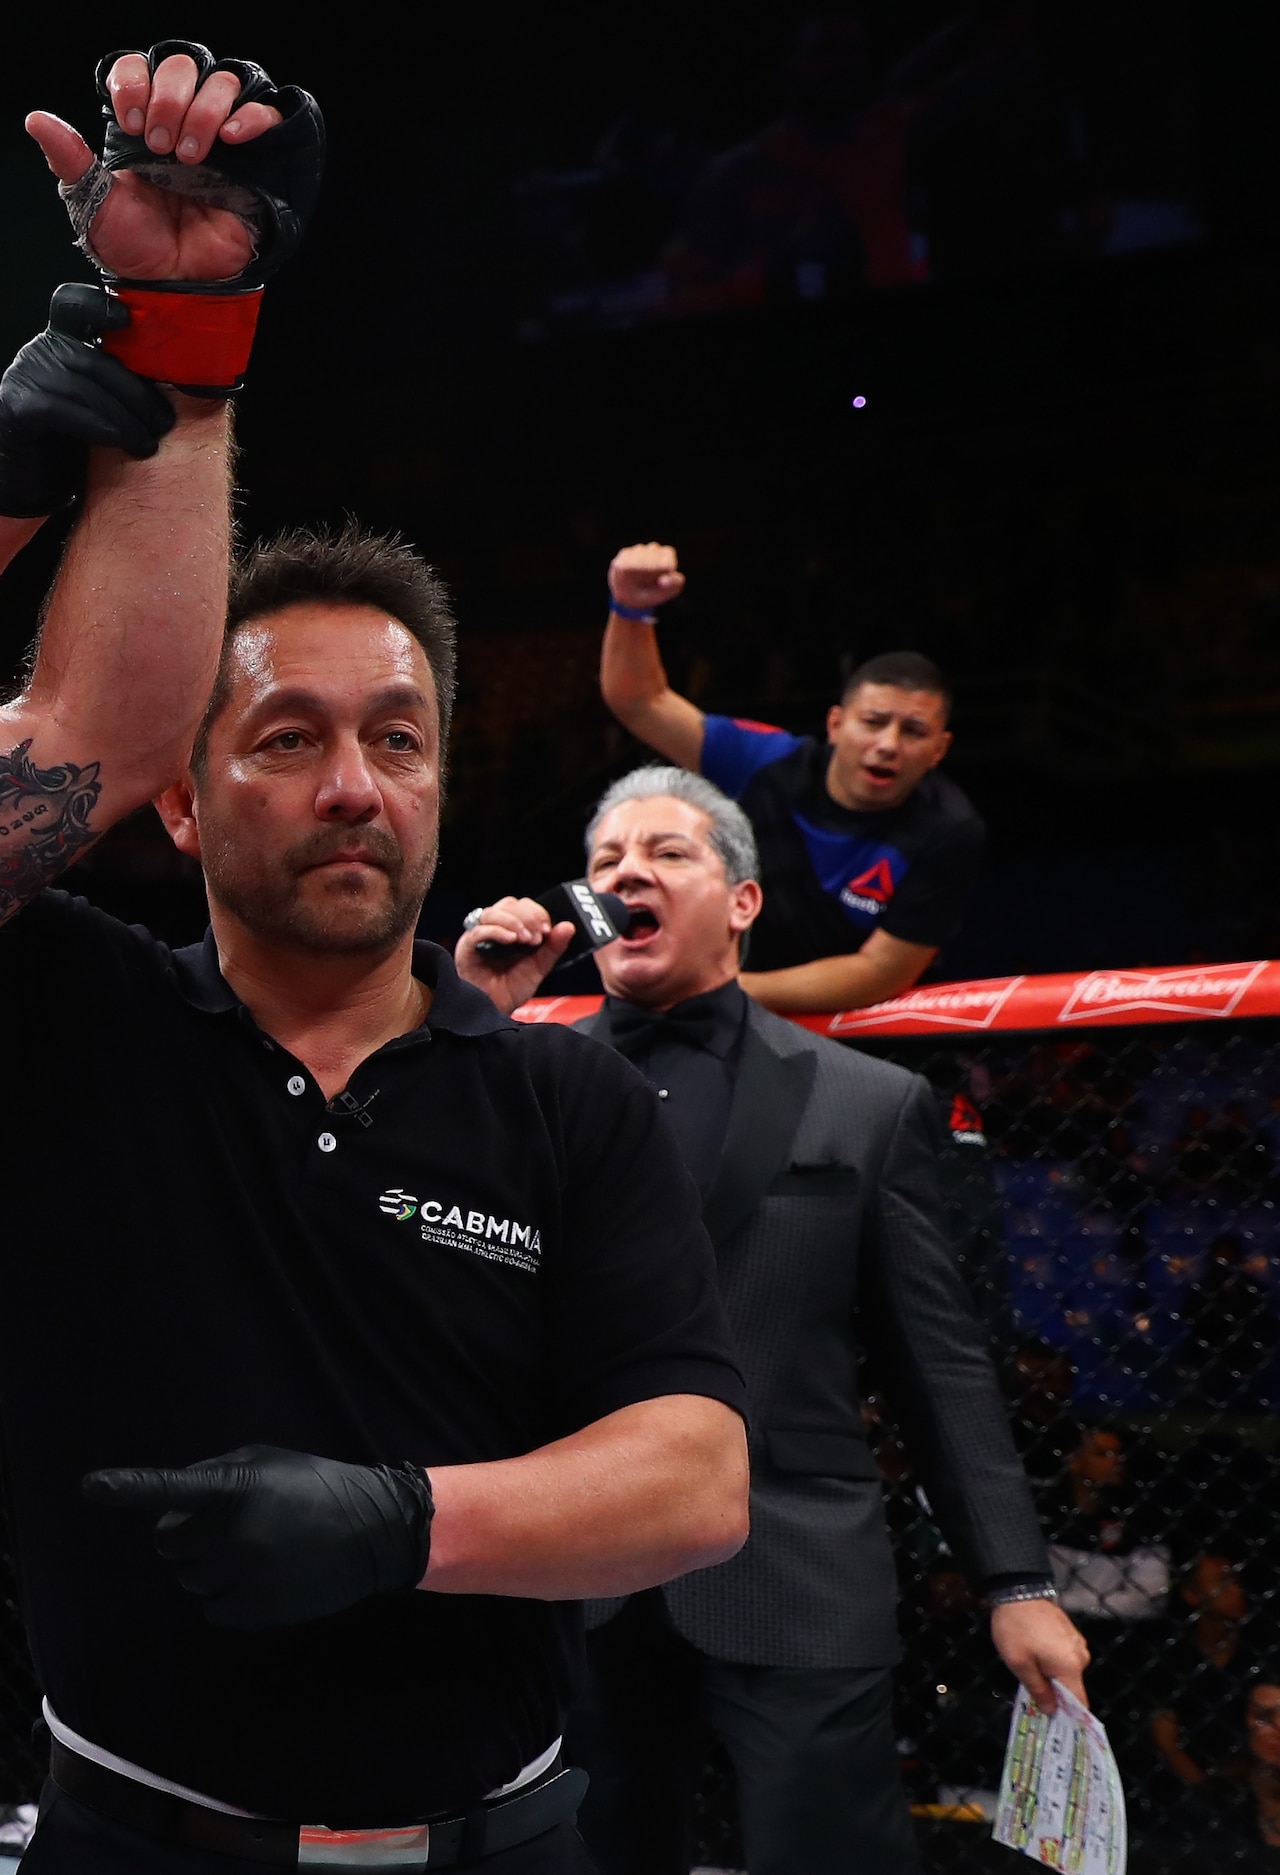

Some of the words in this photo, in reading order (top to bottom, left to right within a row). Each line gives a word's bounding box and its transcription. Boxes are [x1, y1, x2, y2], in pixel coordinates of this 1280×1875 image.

[572, 884, 613, 937] UFC
[852, 988, 1007, 1015] udweiser
[1074, 975, 1248, 1004] Budweiser
[420, 1200, 542, 1255] CABMMA
